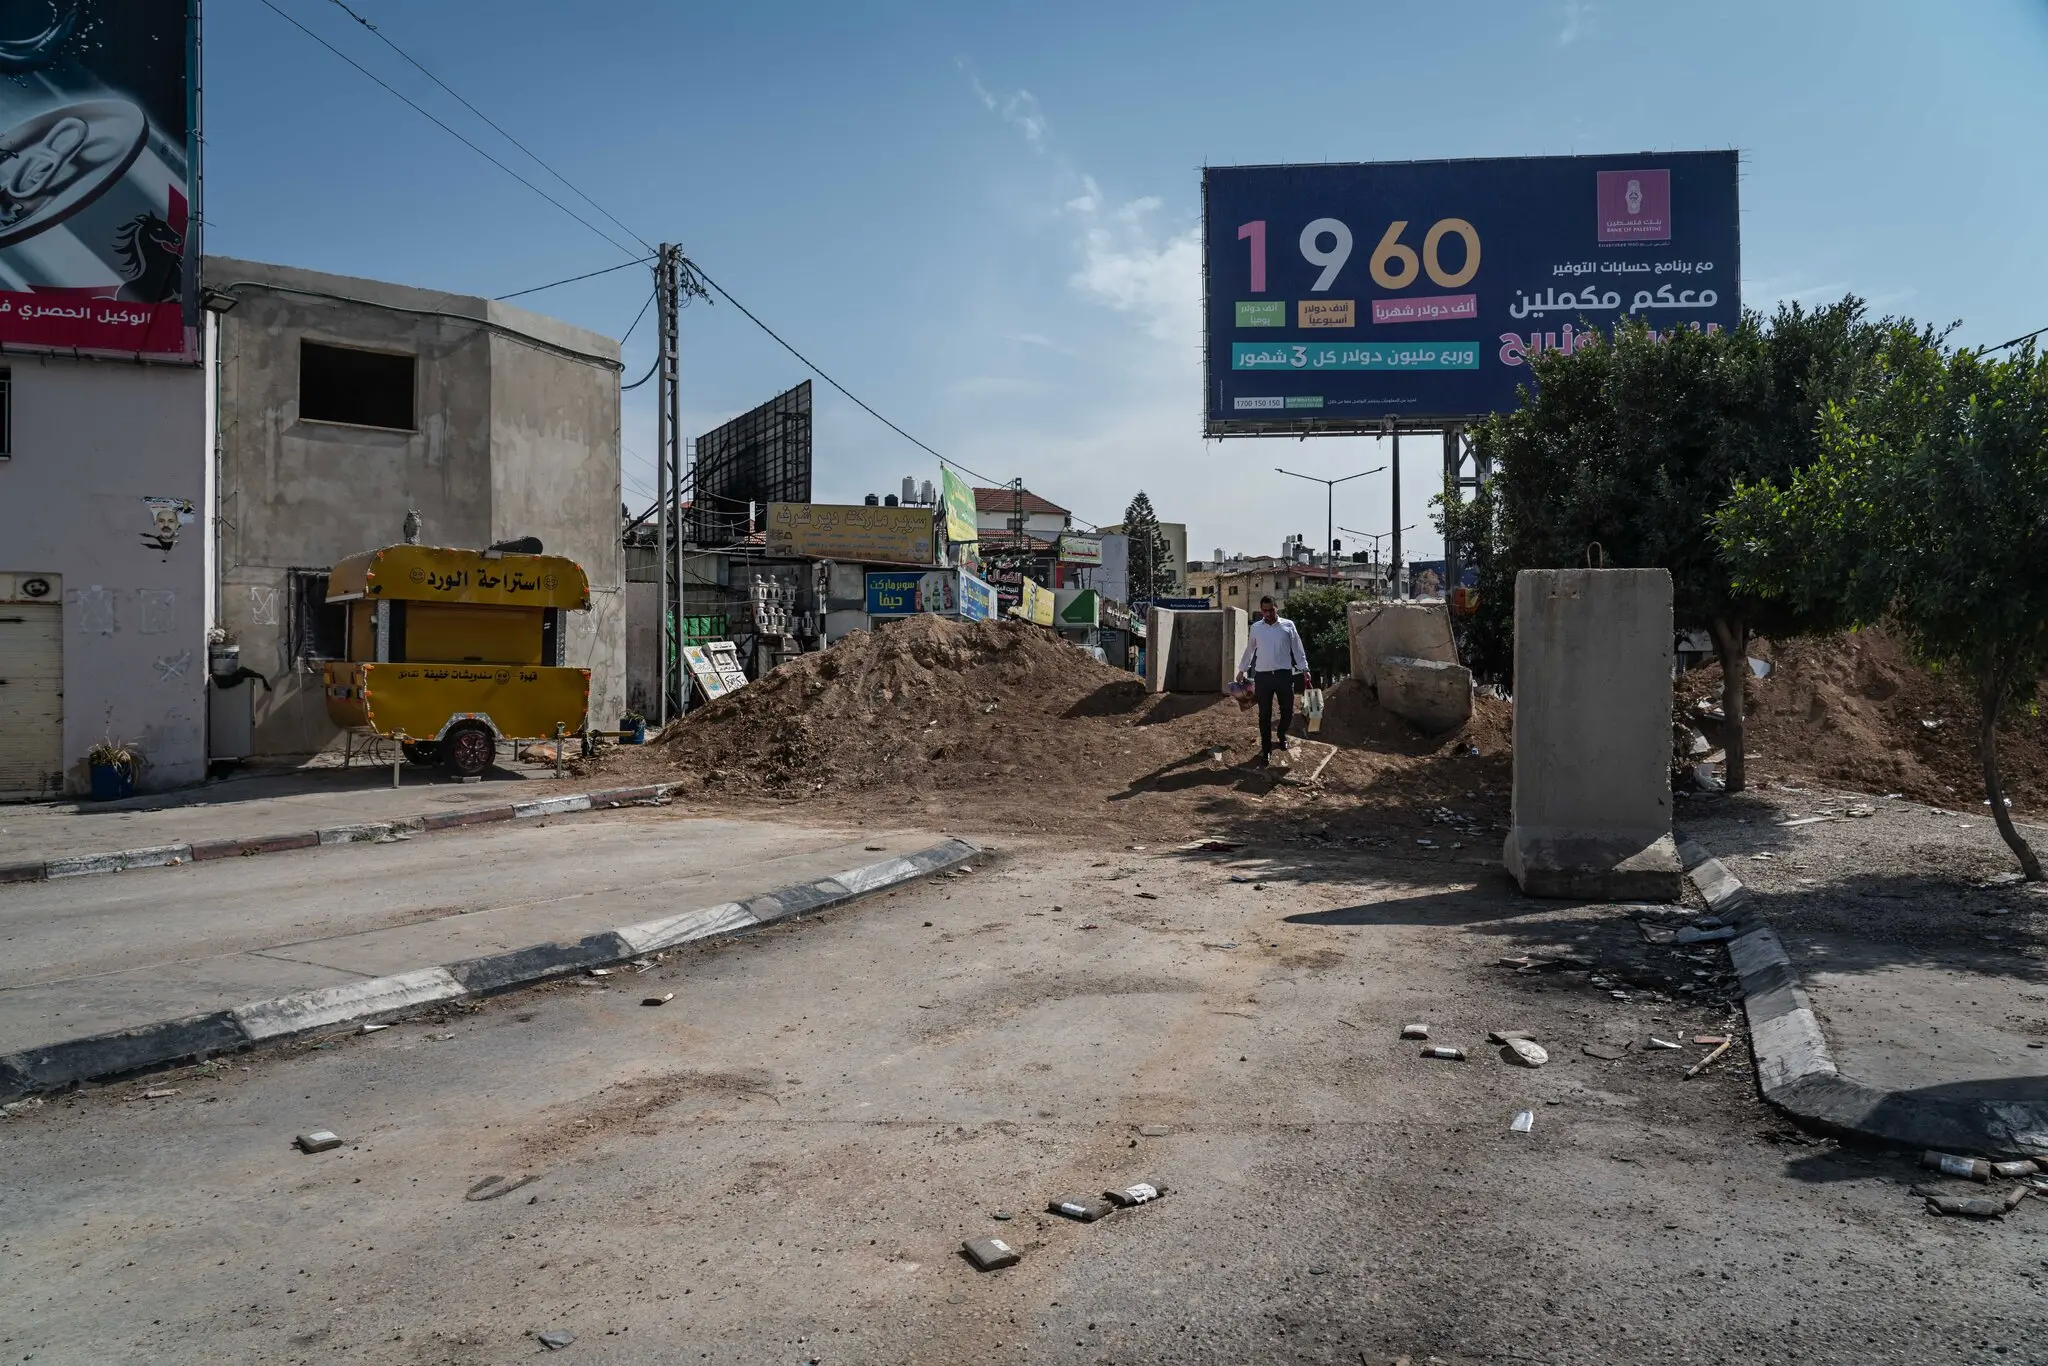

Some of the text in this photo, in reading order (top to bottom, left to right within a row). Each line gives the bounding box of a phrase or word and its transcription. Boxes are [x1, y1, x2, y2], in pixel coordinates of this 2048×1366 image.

[1238, 217, 1481, 292] 1 9 60
[1552, 260, 1713, 276] مع برنامج حسابات التوفير
[1241, 303, 1261, 313] دولار
[1451, 299, 1475, 312] ألف
[1509, 283, 1718, 319] معكم مكملين
[0, 299, 152, 326] الوكيل الحصري ف
[1305, 304, 1327, 314] دولار
[1417, 304, 1448, 317] دولار
[1239, 345, 1474, 367] وربع مليون دولار كل 3 شهور
[1268, 399, 1281, 407] 150
[776, 504, 927, 534] سوبر ماركت دير شرف
[427, 568, 541, 593] استراحة الورد
[878, 591, 903, 609] حيفا
[424, 669, 449, 681] خفيفة
[451, 670, 493, 683] سندويشات
[519, 671, 538, 682] قهوة
